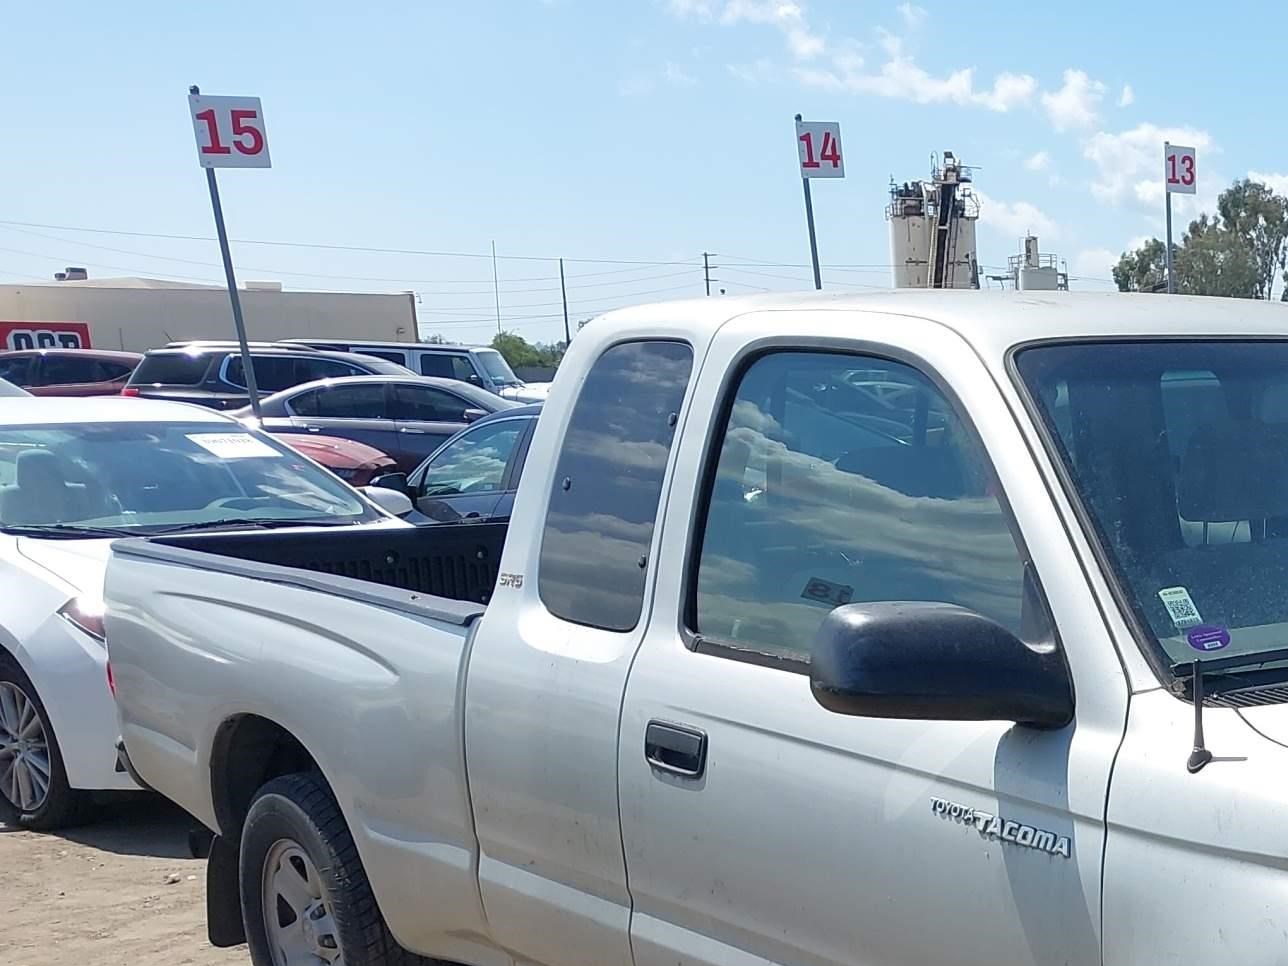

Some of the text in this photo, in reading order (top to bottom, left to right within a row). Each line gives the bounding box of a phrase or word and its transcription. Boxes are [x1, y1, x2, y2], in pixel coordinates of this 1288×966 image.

[196, 109, 264, 155] 15
[799, 132, 841, 168] 14
[1167, 154, 1195, 185] 13
[930, 796, 1071, 858] TOYOTA TACOMA
